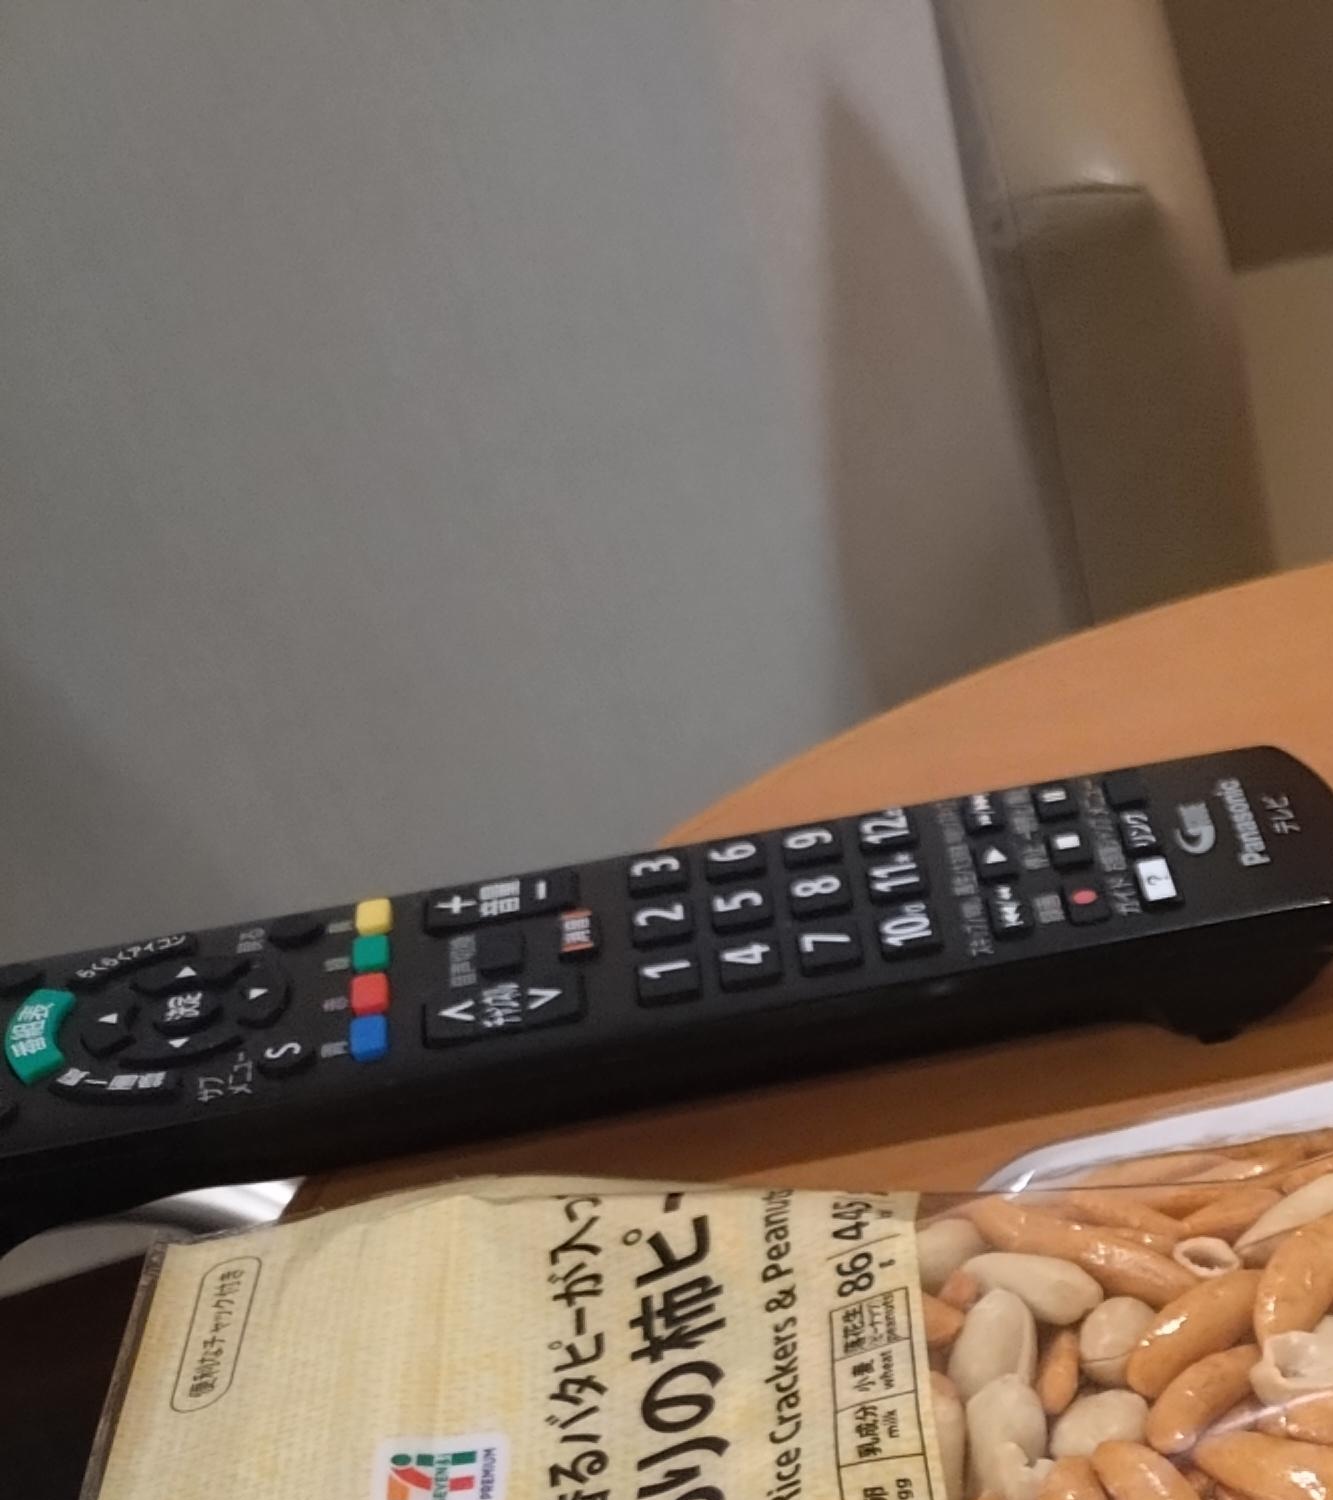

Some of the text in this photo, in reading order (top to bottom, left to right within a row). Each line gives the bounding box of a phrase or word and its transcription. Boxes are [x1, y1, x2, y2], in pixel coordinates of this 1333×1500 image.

[1213, 777, 1271, 867] Panasonic
[784, 828, 833, 849] 9
[708, 842, 756, 862] 6
[631, 857, 680, 877] 3
[791, 875, 841, 898] 8
[713, 891, 763, 912] 5
[633, 902, 685, 926] 2
[721, 942, 770, 965] 4
[801, 932, 850, 953] 7
[638, 959, 692, 980] 1
[264, 1042, 301, 1059] S
[836, 1251, 875, 1298] 86
[764, 1284, 797, 1312] &
[765, 1315, 803, 1446] Crackers
[856, 1403, 881, 1458] 乳成分
[480, 1447, 497, 1500] PREMIUM
